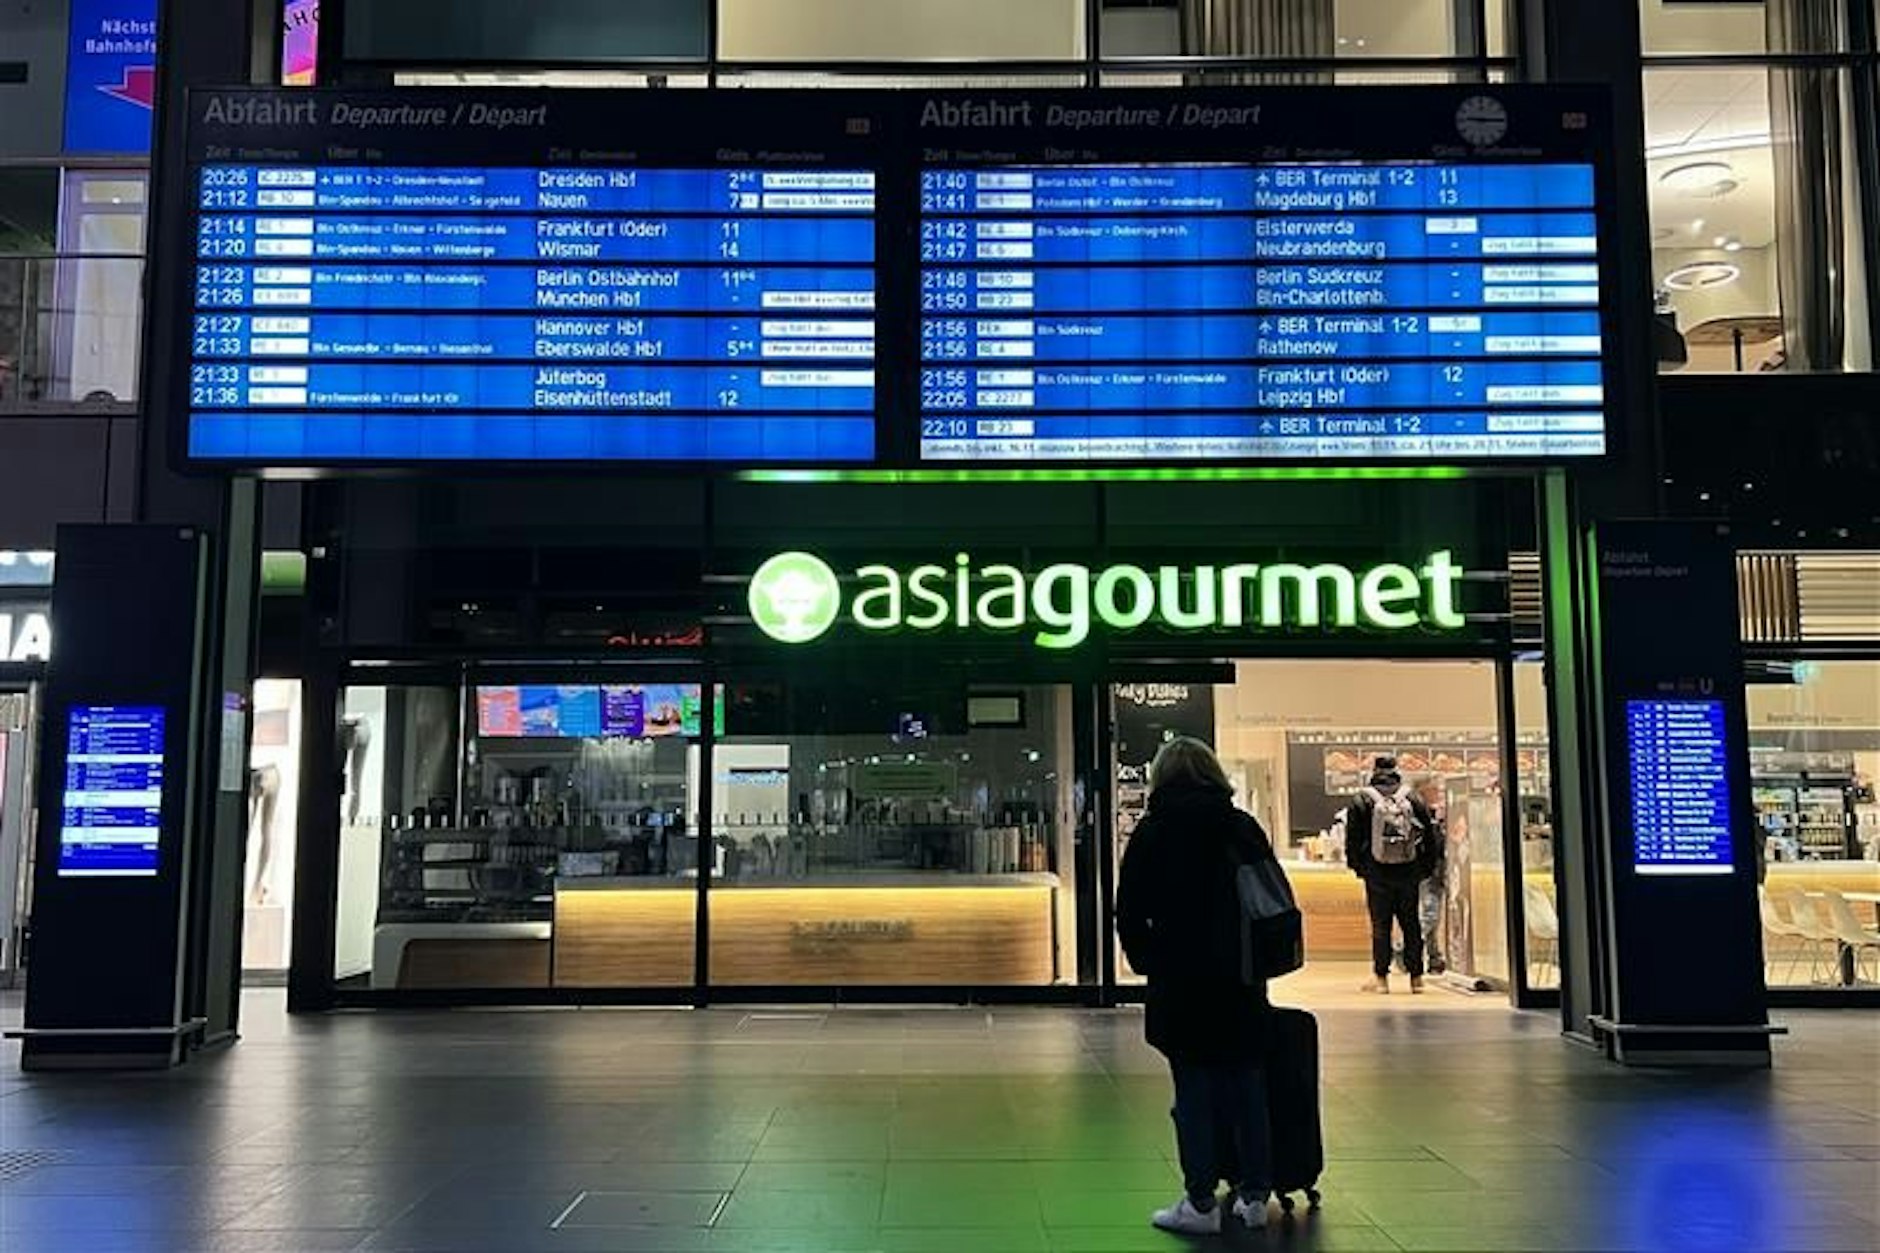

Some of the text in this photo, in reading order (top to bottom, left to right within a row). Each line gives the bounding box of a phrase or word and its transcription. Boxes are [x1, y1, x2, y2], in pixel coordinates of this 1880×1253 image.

[204, 97, 317, 125] Abfahrt
[331, 103, 447, 128] Departure
[920, 100, 1032, 127] Abfahrt
[1046, 105, 1159, 130] Departure
[203, 169, 248, 186] 20:26
[539, 170, 605, 188] Dresden
[609, 170, 637, 188] Hbf
[923, 173, 967, 190] 21:40
[1275, 170, 1306, 187] BER
[1312, 169, 1381, 187] Terminal
[1388, 169, 1415, 186] 1-2
[1438, 168, 1458, 185] 11
[203, 189, 247, 207] 21:12
[538, 191, 588, 208] Nauen
[923, 193, 966, 209] 21:41
[1255, 190, 1344, 211] Magdeburg
[1348, 190, 1377, 206] Hbf
[1438, 189, 1458, 205] 13
[200, 218, 246, 235] 21:14
[537, 220, 615, 237] Frankfurt
[619, 220, 668, 238] (Oder)
[721, 222, 739, 239] 11
[923, 222, 967, 239] 21:42
[1255, 219, 1355, 236] Elsterwerda
[200, 239, 246, 256] 21:20
[537, 241, 602, 257] Wismar
[719, 241, 739, 258] 14
[923, 241, 1386, 260] 21:47 Neubrandenburg
[199, 267, 244, 284] 21:23
[537, 269, 584, 286] Berlin
[588, 269, 680, 287] Ostbahnhof
[1255, 268, 1303, 285] Berlin
[199, 288, 244, 305] 21:26
[613, 290, 641, 307] Hbf
[923, 292, 967, 310] 21:50
[196, 317, 643, 336] 21:27 Hannover Hbf
[923, 321, 967, 338] 21:56
[1277, 317, 1308, 335] BER
[1314, 317, 1385, 334] Terminal
[1392, 316, 1419, 334] 1-2
[196, 338, 241, 355] 21:33
[535, 340, 630, 357] Eberswalde
[635, 340, 662, 357] Hbf
[923, 341, 967, 358] 21:56
[1257, 338, 1338, 355] Rathenow
[194, 366, 239, 382] 21:33
[923, 370, 967, 388] 21:56
[1258, 367, 1335, 384] Frankfurt
[1341, 366, 1390, 385] (Oder)
[1443, 366, 1463, 383] 12
[194, 387, 239, 404] 21:36
[717, 390, 739, 407] 12
[923, 391, 967, 409] 22:05
[1258, 389, 1313, 408] Leipzig
[1316, 388, 1346, 404] Hbf
[923, 420, 967, 437] 22:10
[1279, 418, 1311, 435] BER
[1316, 417, 1386, 434] Terminal
[1393, 416, 1421, 433] 1-2
[850, 549, 1464, 649] asiagourmet
